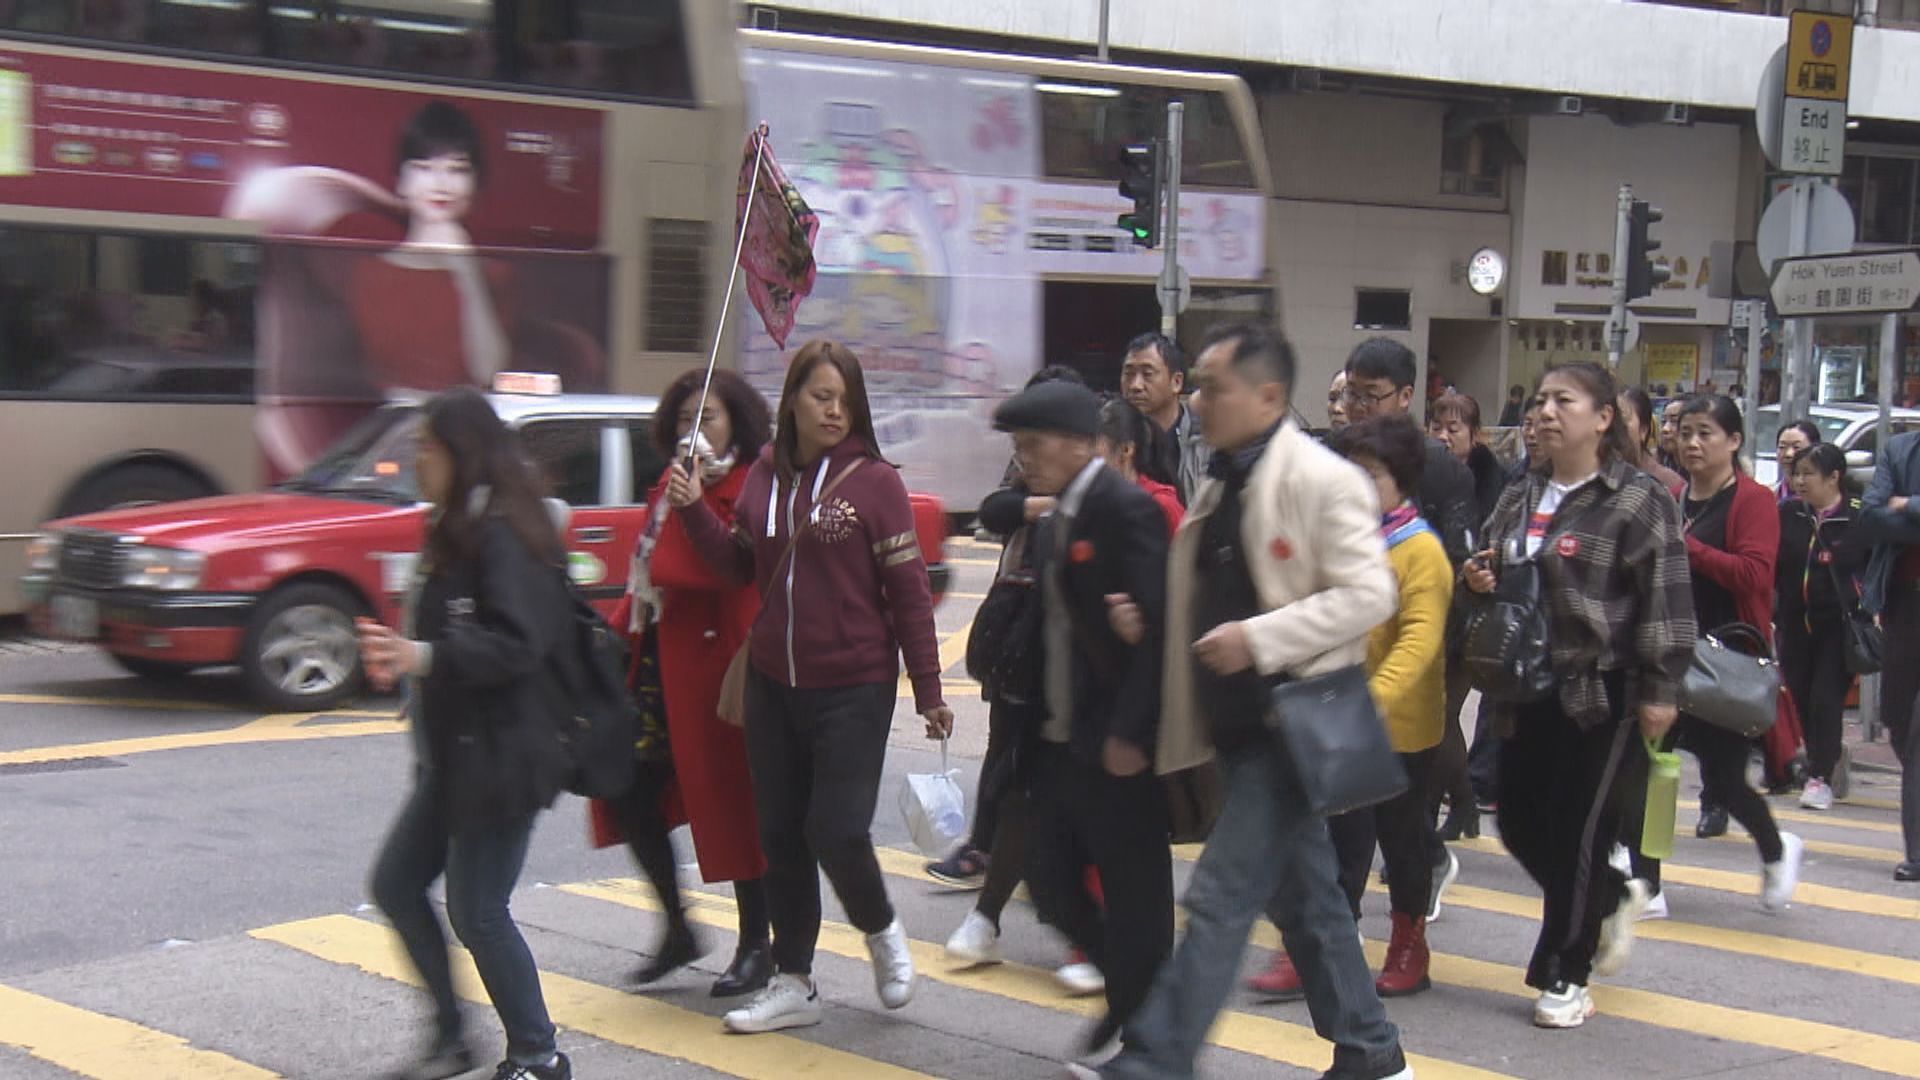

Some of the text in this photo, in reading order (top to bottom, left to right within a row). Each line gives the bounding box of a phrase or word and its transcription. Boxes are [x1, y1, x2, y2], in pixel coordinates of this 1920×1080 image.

[1801, 108, 1829, 129] End
[1793, 136, 1832, 164] 終止
[1791, 259, 1903, 280] Hok Yuen Street
